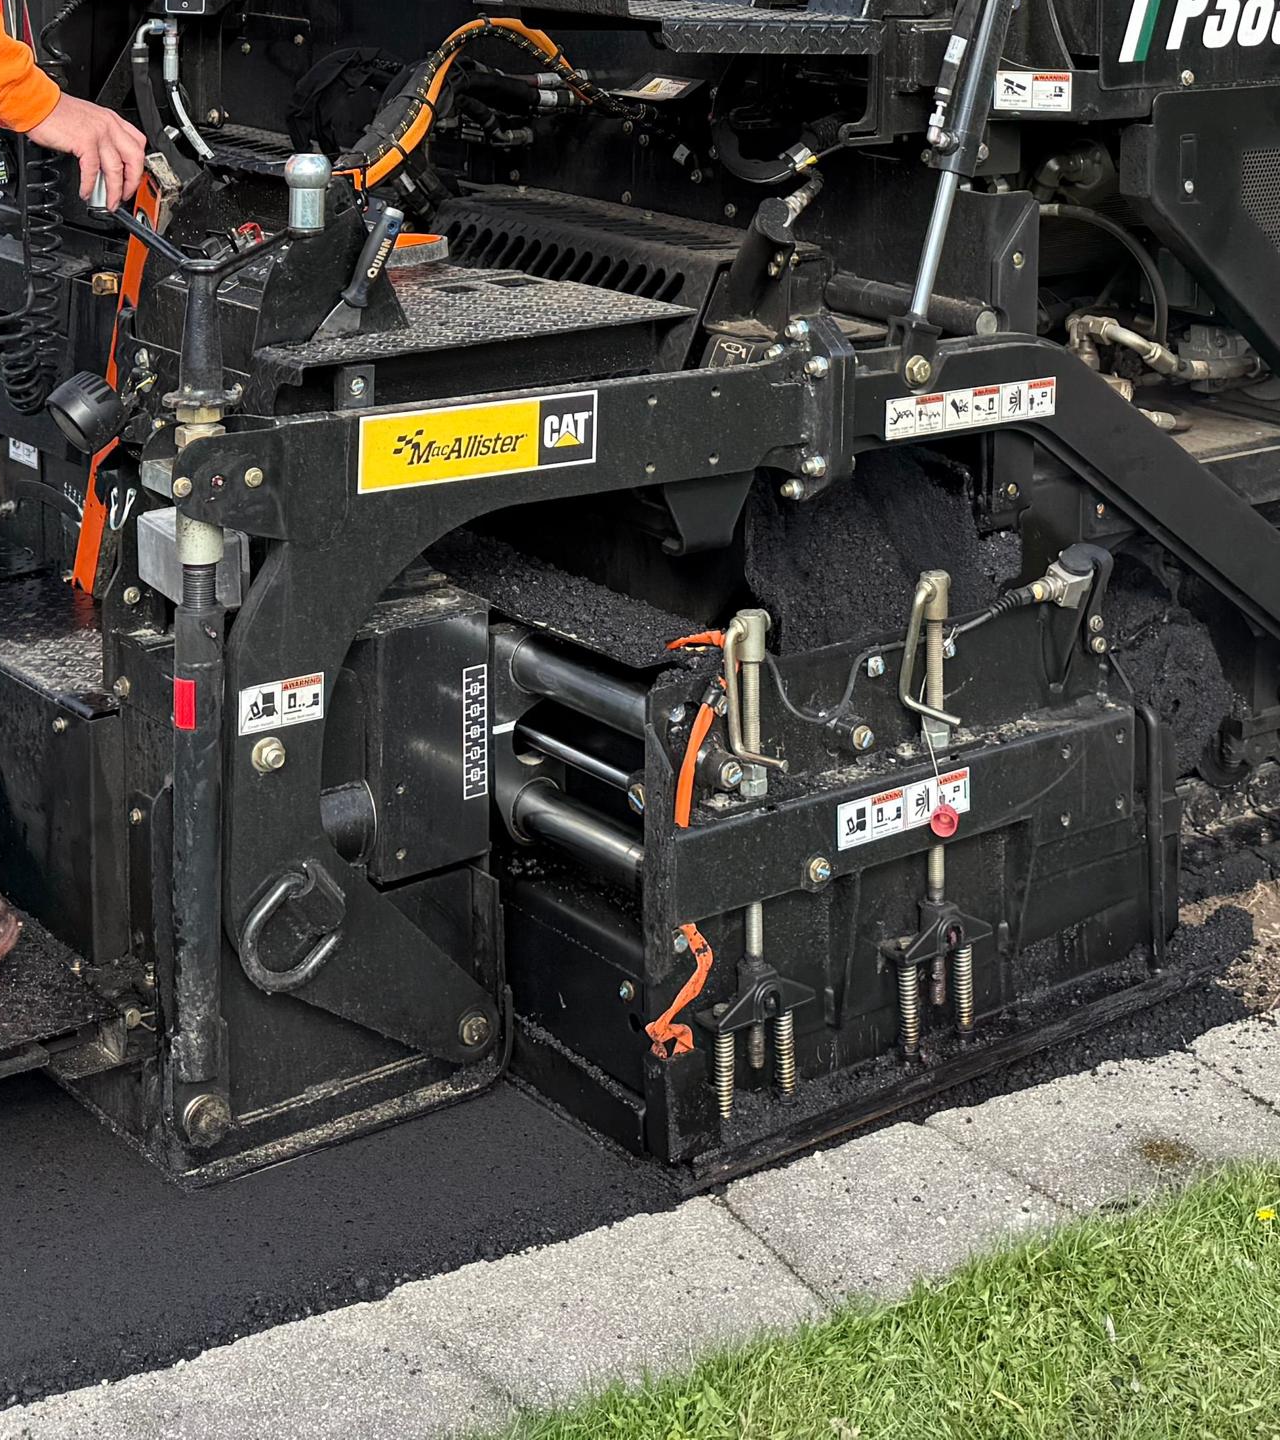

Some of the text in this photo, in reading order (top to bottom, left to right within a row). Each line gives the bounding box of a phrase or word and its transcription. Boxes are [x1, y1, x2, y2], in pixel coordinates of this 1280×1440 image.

[367, 237, 392, 278] QUINN
[407, 411, 589, 465] MacAllister CAT
